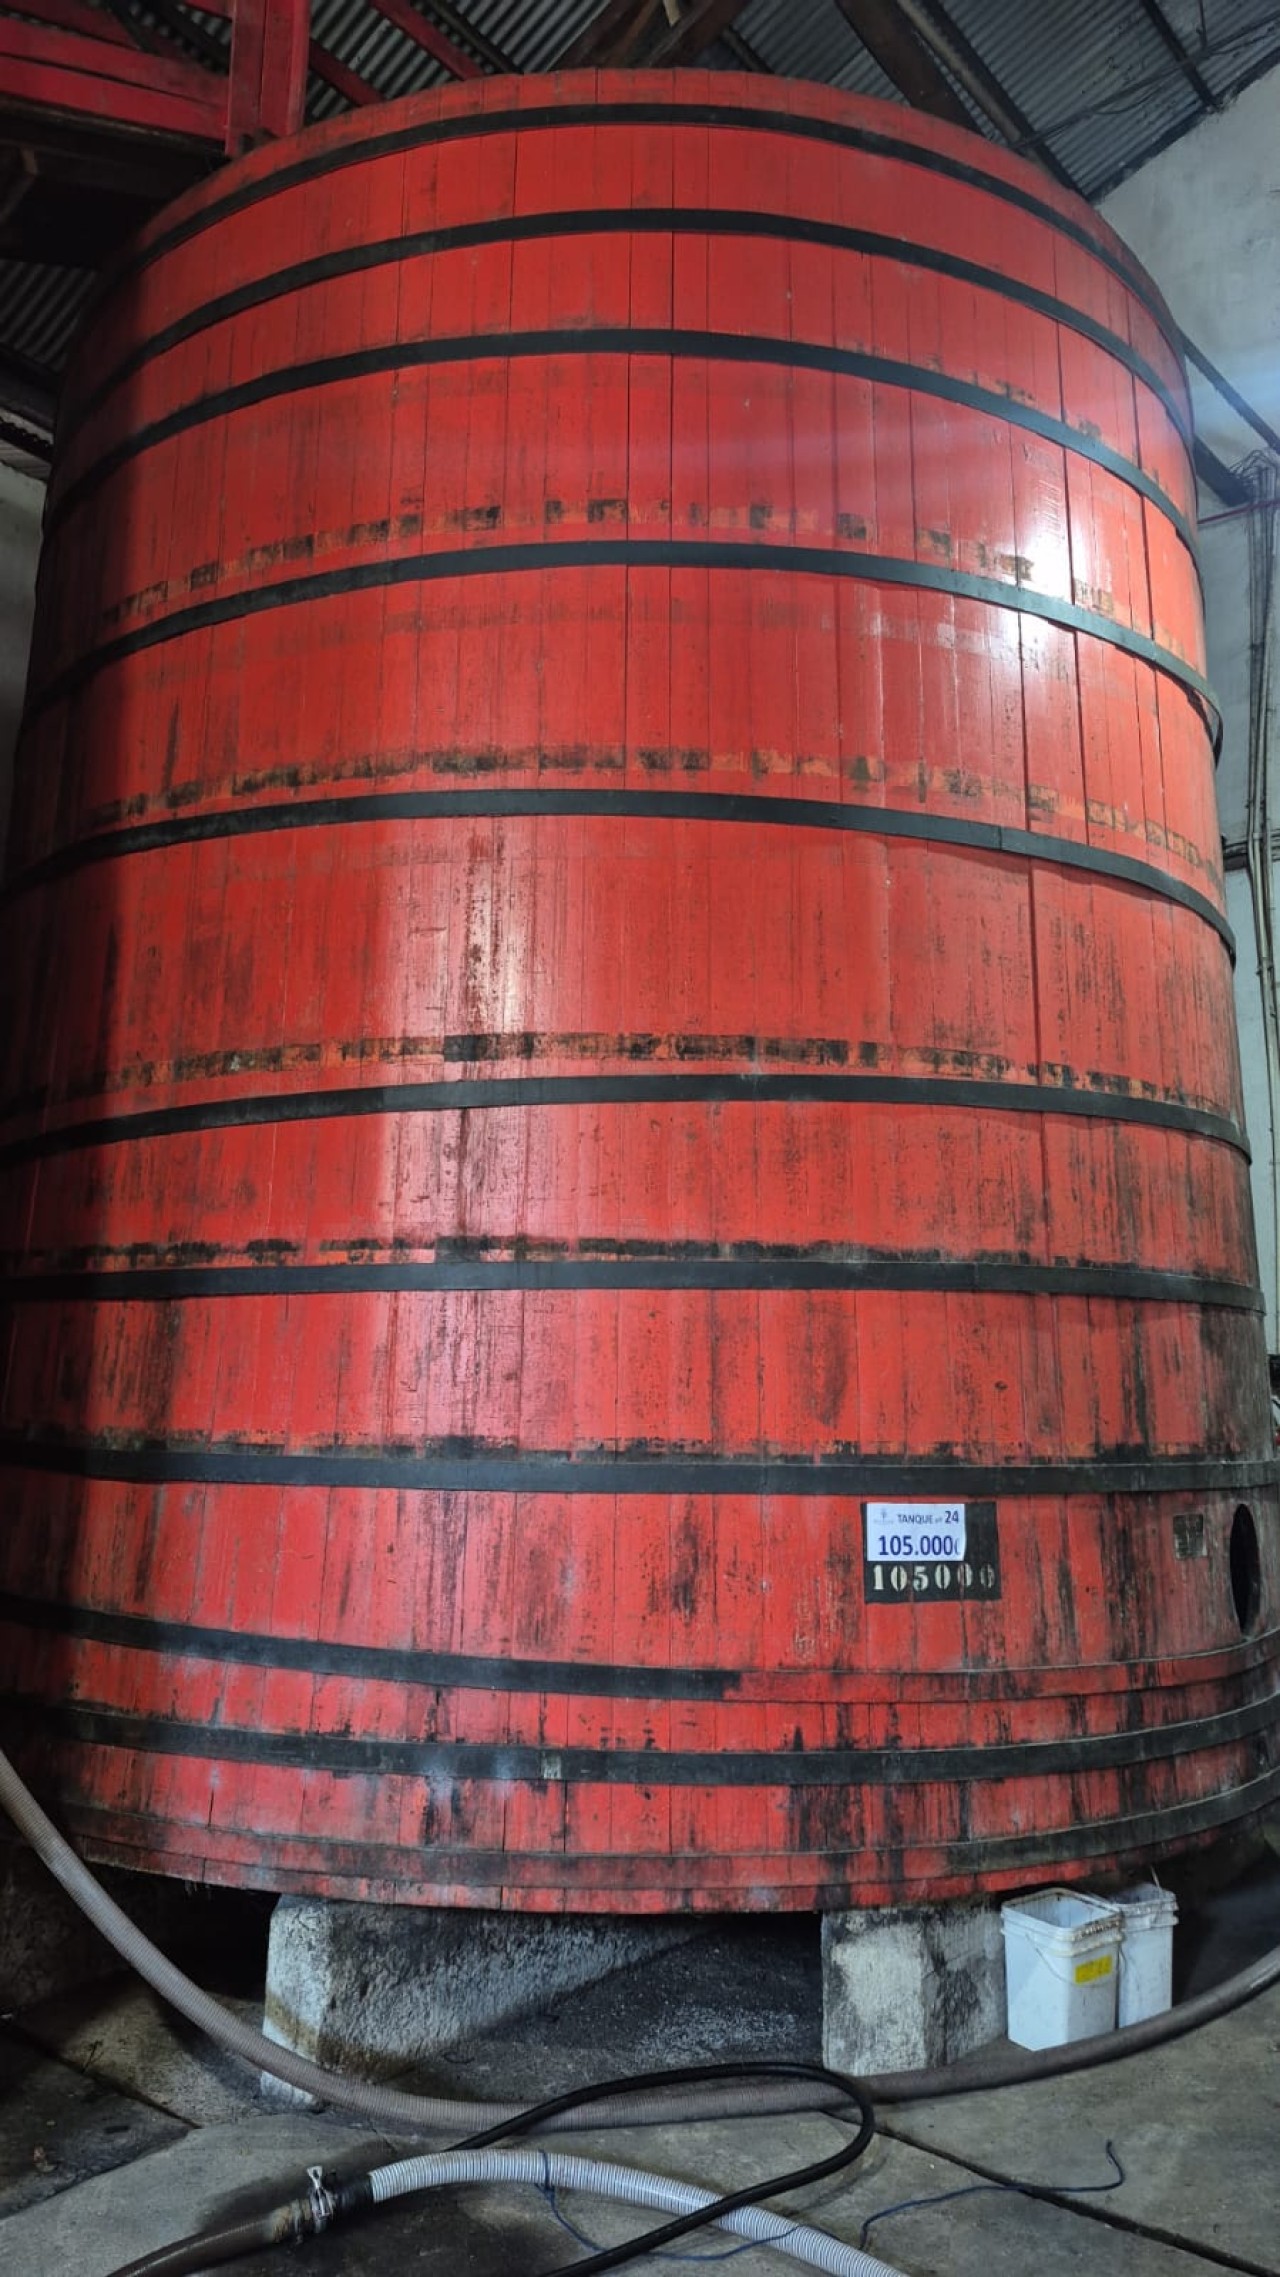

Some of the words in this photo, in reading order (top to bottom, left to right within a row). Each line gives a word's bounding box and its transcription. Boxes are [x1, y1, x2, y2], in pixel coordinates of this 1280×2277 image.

[897, 1514, 933, 1525] TANQUE
[944, 1510, 959, 1525] 24
[872, 1563, 996, 1592] 105000
